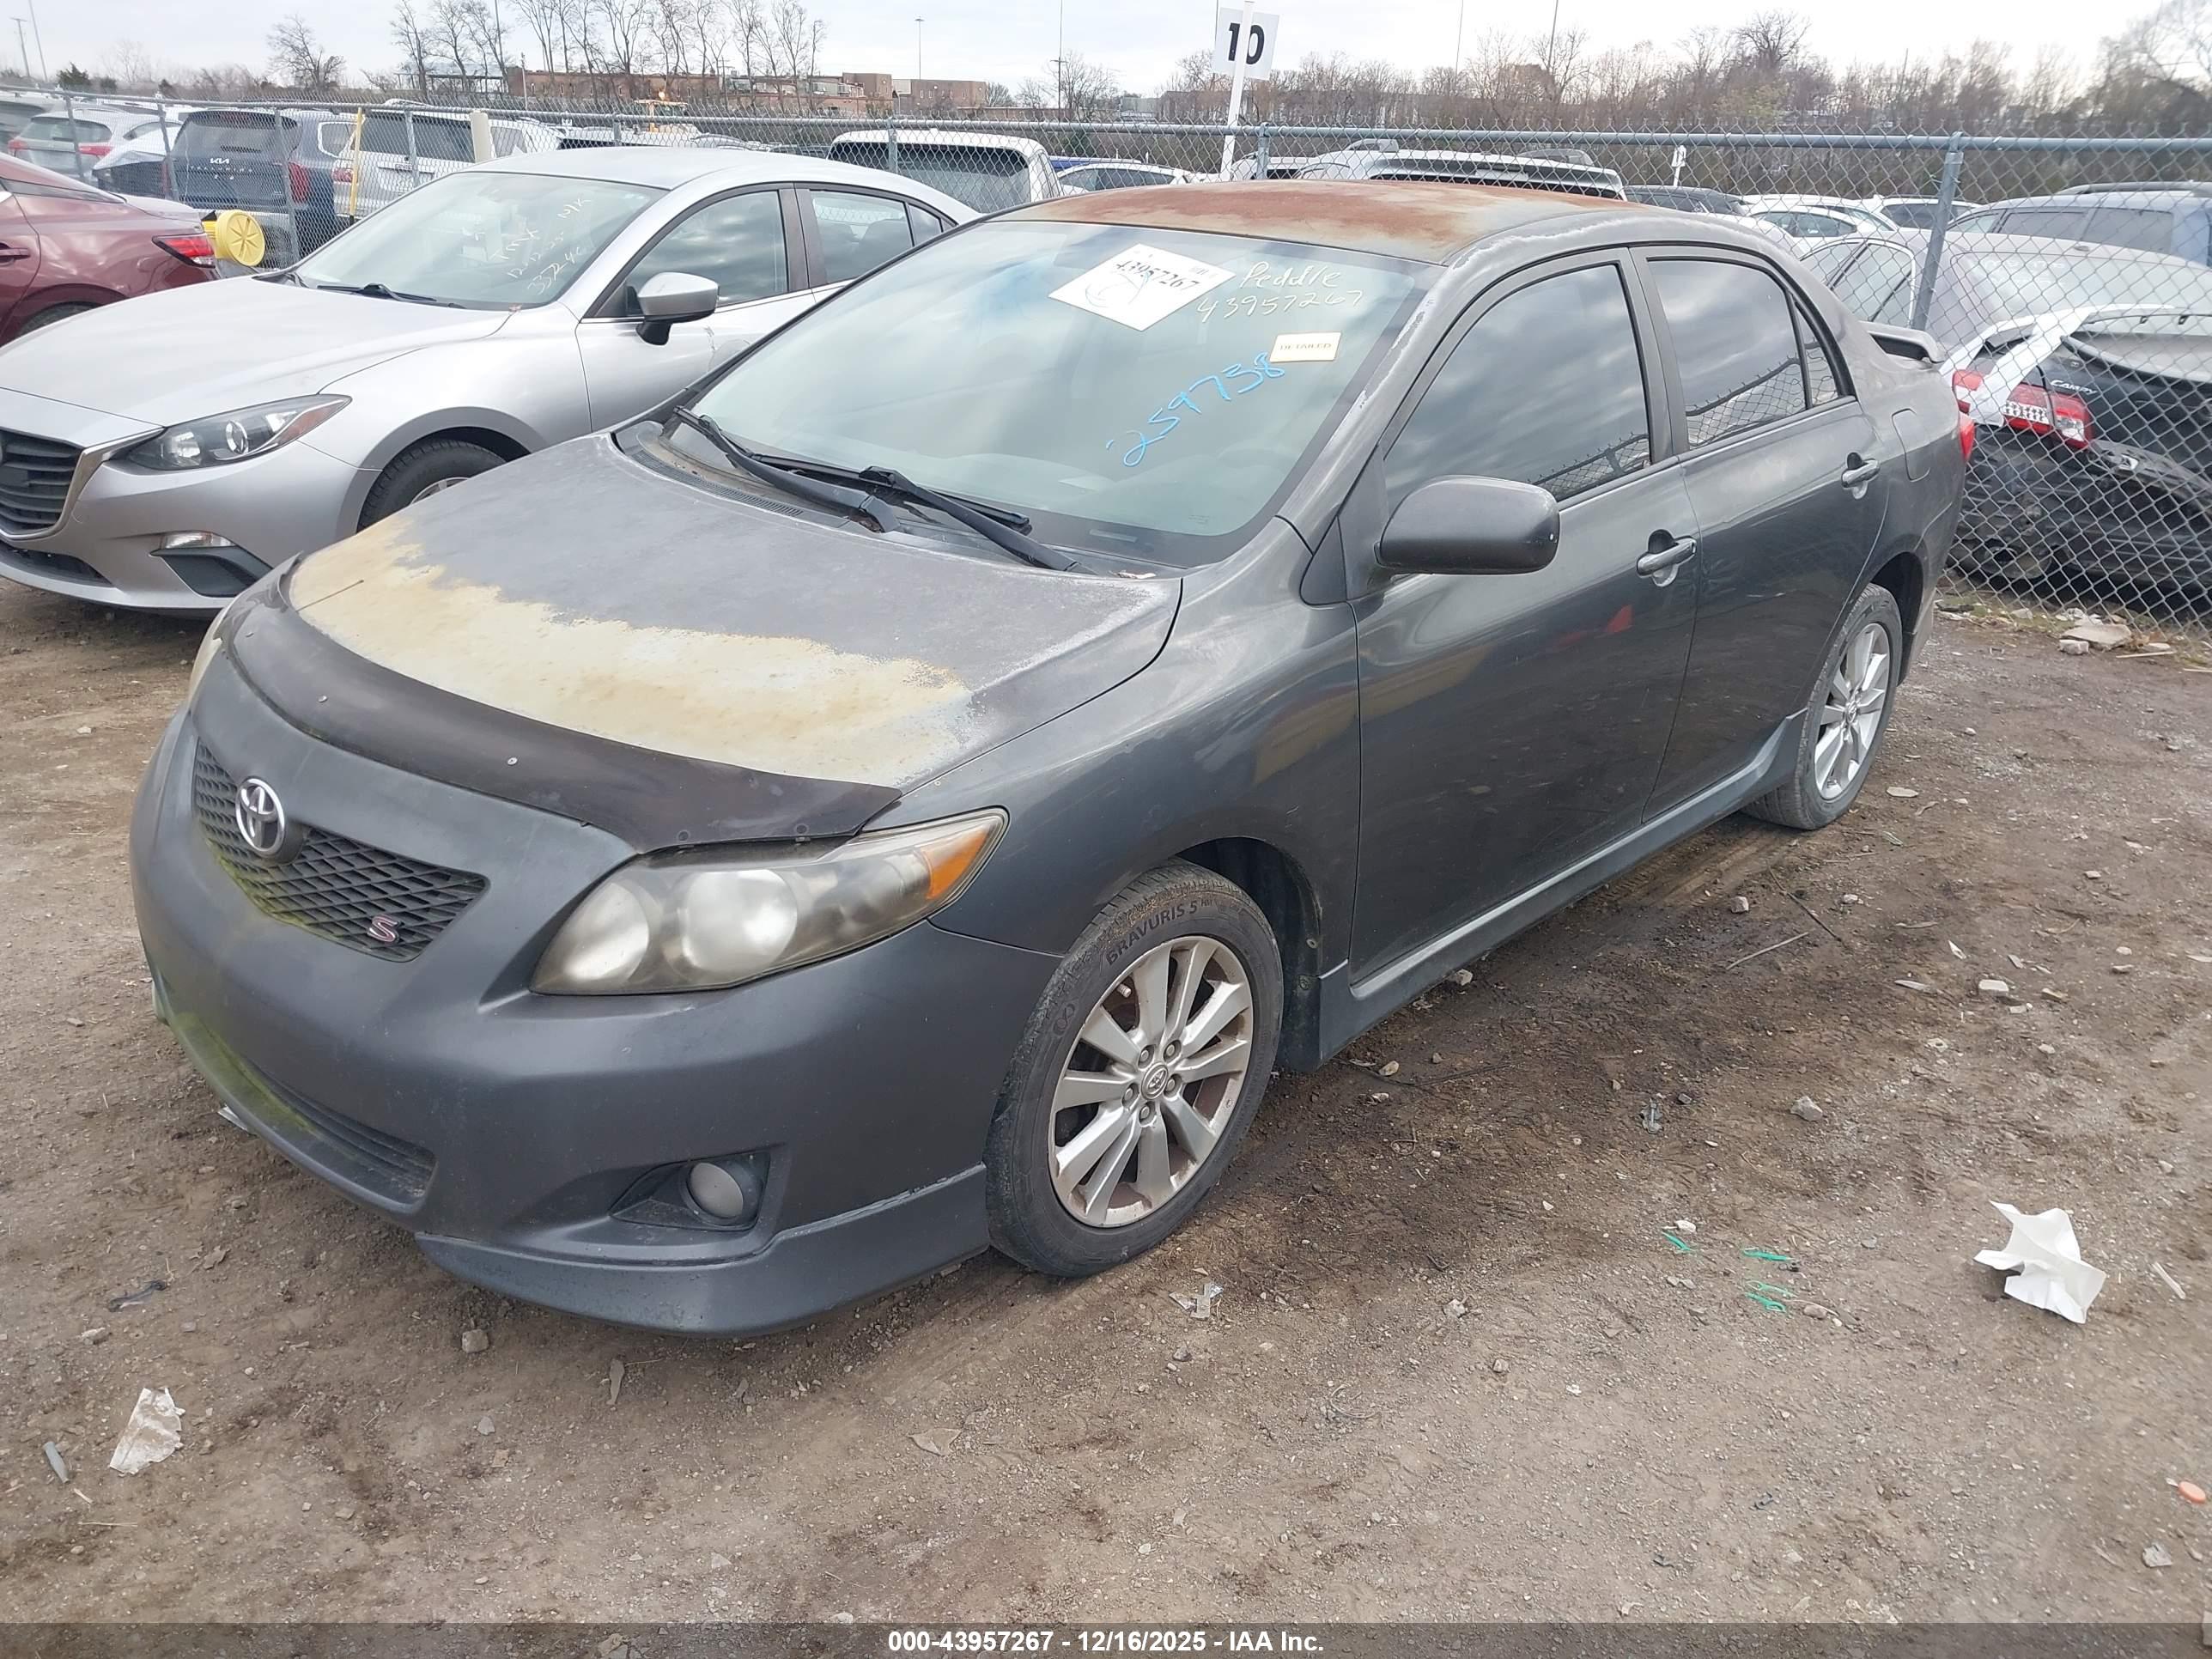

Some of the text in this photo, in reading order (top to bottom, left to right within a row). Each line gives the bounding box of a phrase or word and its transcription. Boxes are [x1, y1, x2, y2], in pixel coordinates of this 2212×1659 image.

[1228, 22, 1264, 64] 10
[1115, 259, 1200, 291] 43957267
[1240, 261, 1342, 289] Peddle
[1197, 289, 1363, 323] 43957267
[1106, 352, 1285, 466] 259738
[367, 915, 402, 945] S
[1105, 905, 1185, 966] BRAVURIS
